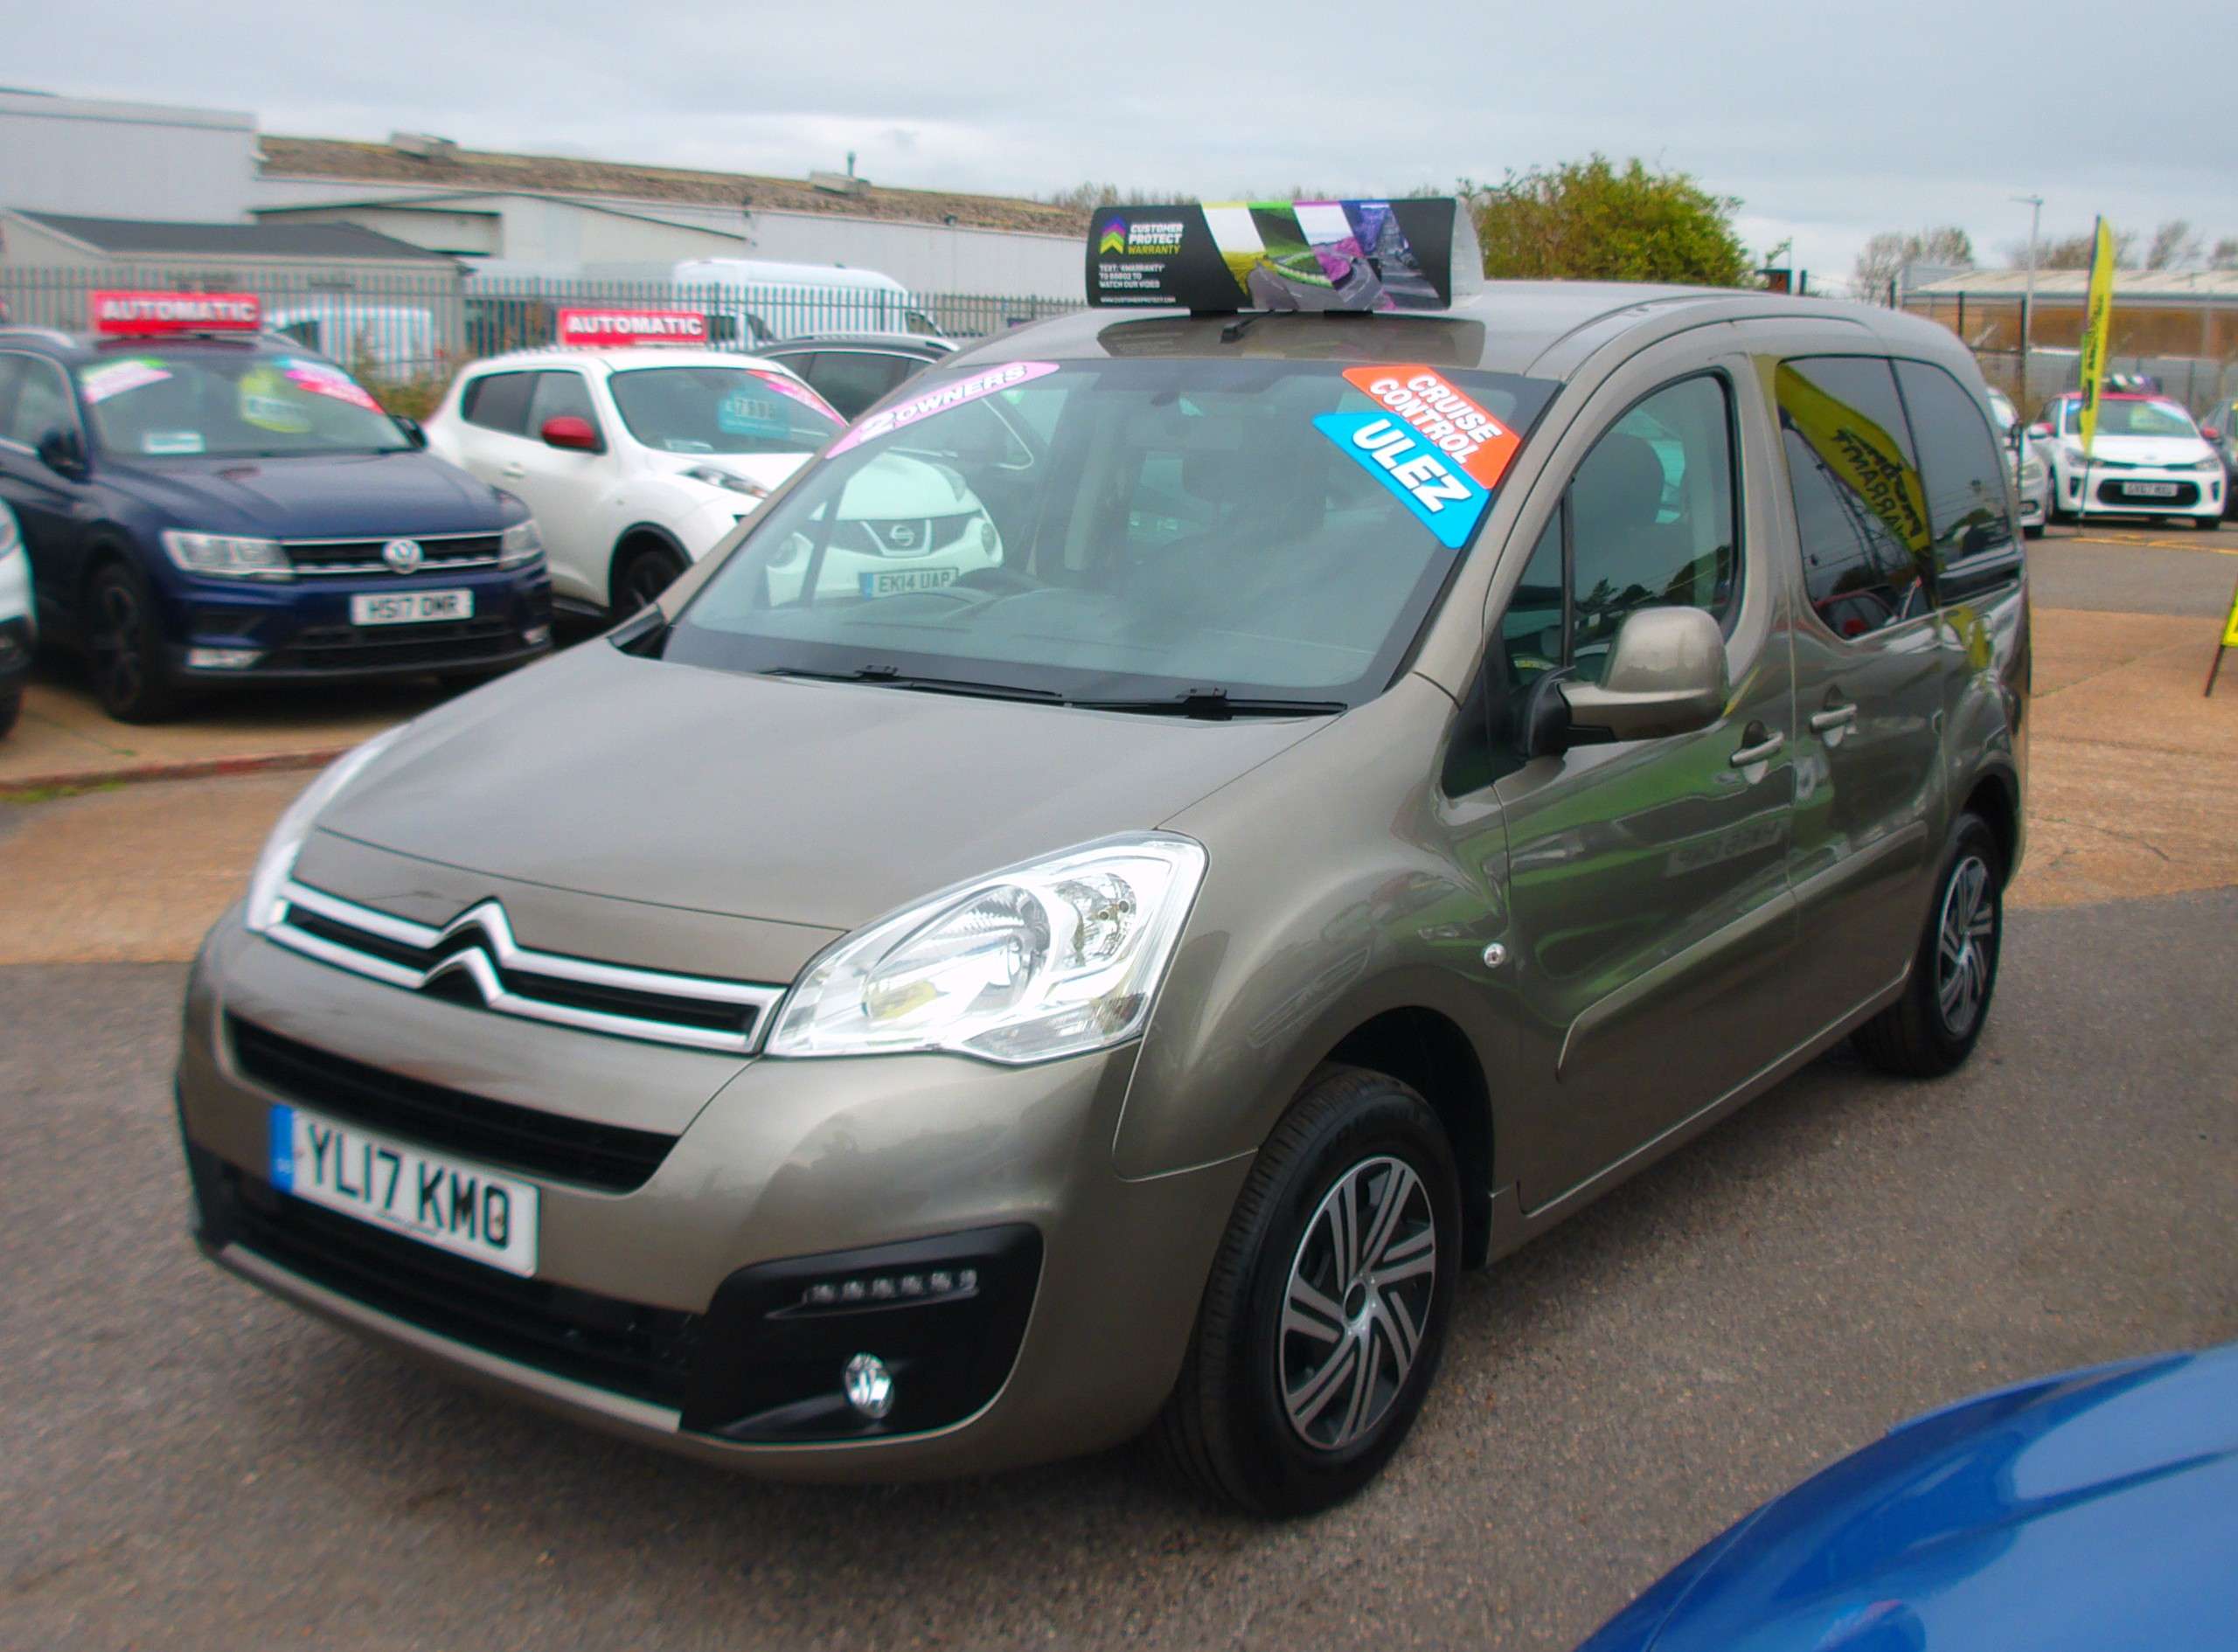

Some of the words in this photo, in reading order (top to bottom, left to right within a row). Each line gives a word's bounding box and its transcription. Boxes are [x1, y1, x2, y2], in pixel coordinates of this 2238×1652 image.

[1129, 233, 1183, 244] PROTECT
[1130, 223, 1184, 233] CUSTOMER
[1129, 245, 1181, 254] WARRANTY
[102, 300, 256, 321] AUTOMATIC
[568, 316, 703, 336] AUTOMATIC
[859, 411, 896, 443] 2
[894, 364, 1028, 422] OWNERS
[1406, 374, 1504, 444] CRUISE
[1369, 378, 1480, 465] CONTROL
[1352, 418, 1473, 513] ULEZ
[879, 573, 916, 593] EK14
[308, 1124, 402, 1211] YL17
[418, 1161, 509, 1251] KMO
